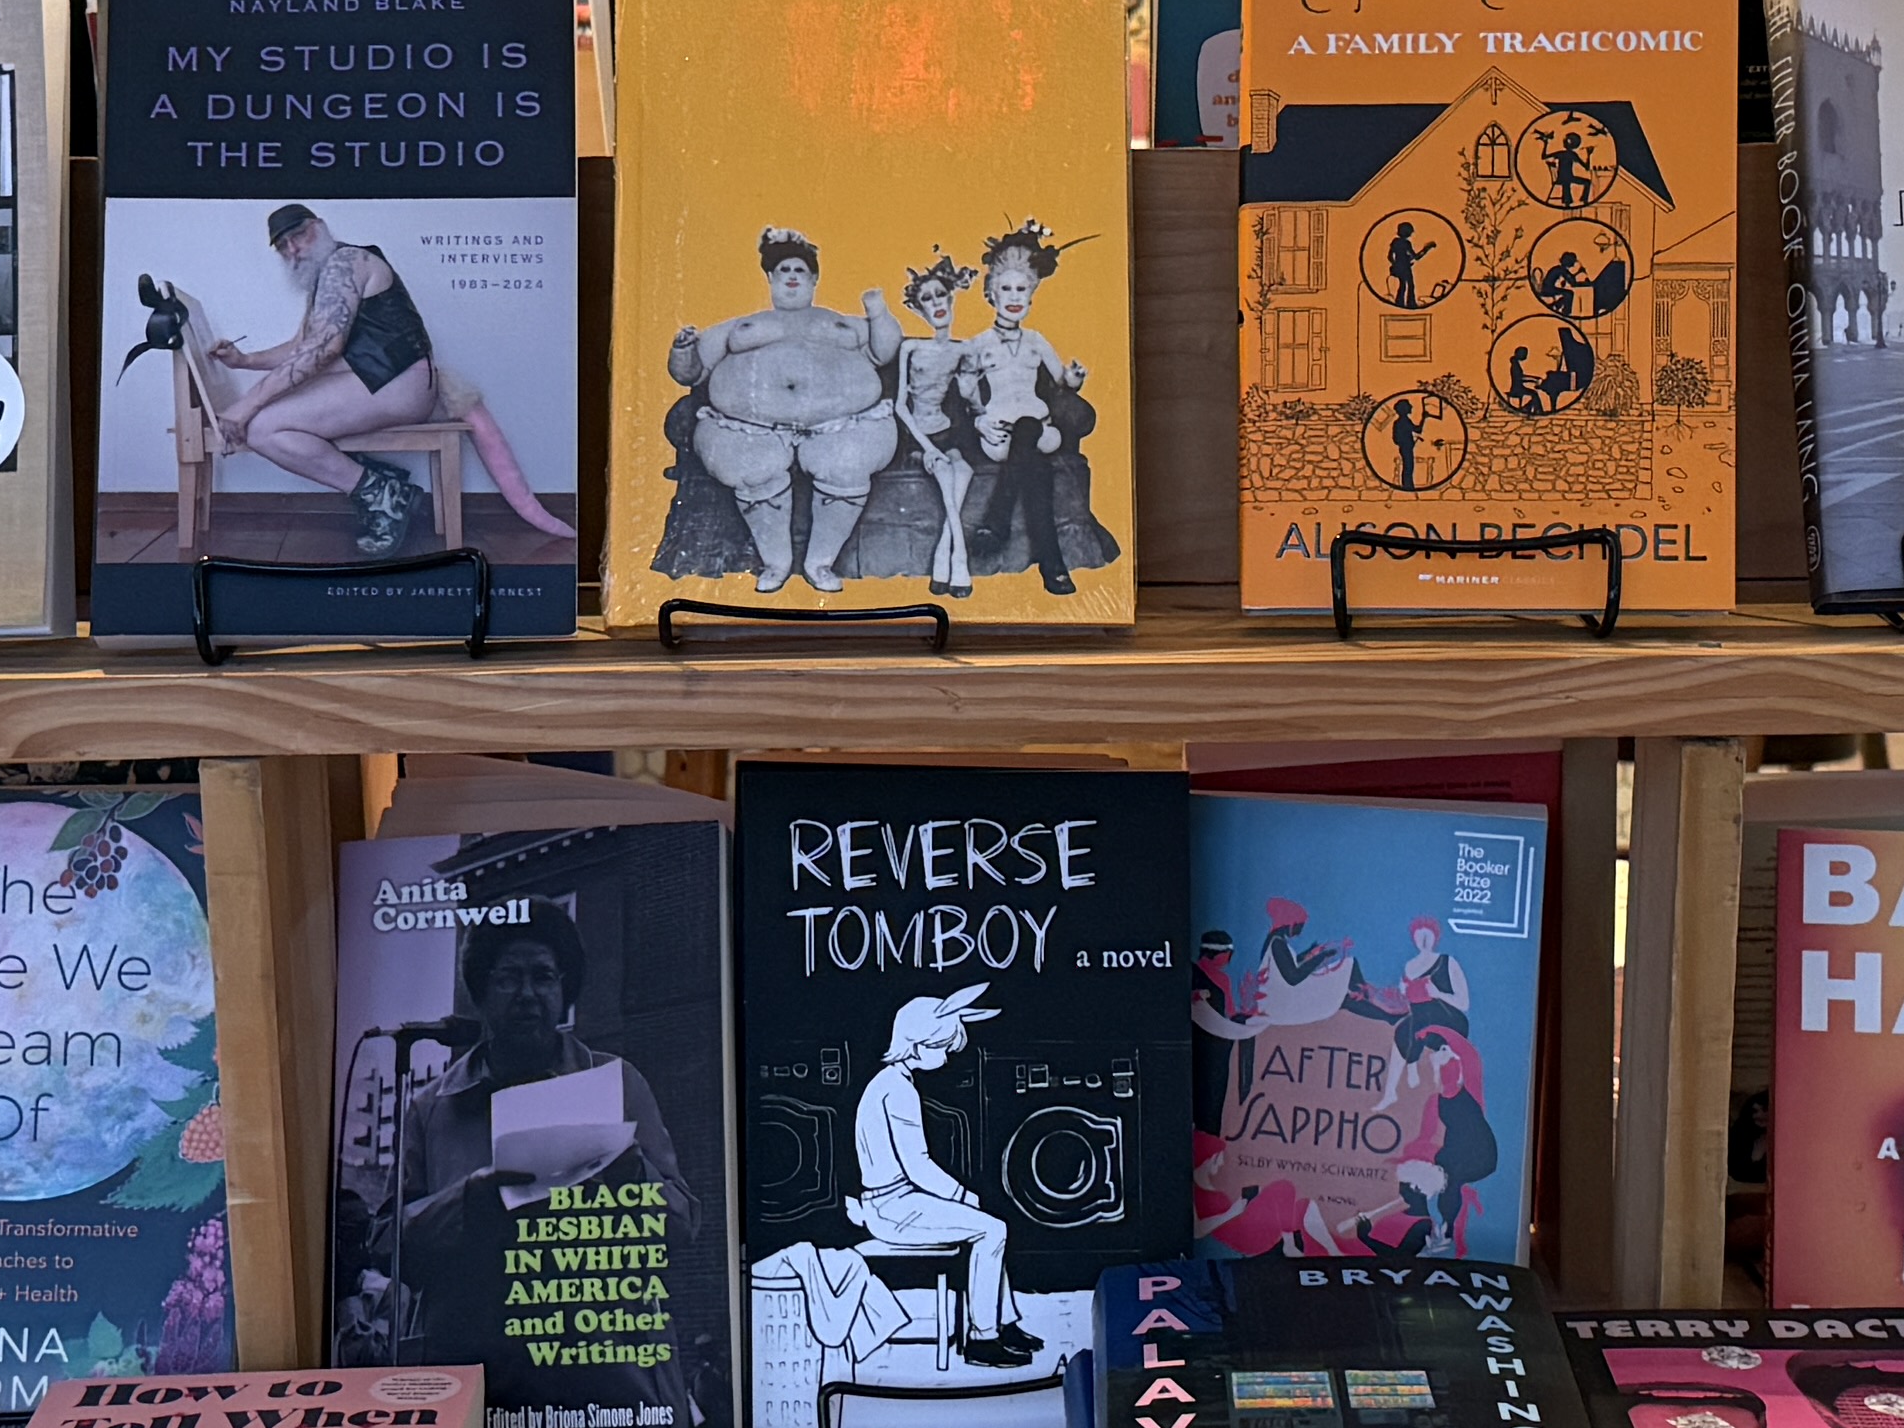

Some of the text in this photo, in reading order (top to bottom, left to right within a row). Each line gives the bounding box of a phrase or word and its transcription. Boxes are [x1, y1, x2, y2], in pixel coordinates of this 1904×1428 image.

[1288, 30, 1704, 56] A FAMILY TRAGICOMIC
[166, 42, 530, 75] MY STUDIO IS
[149, 89, 543, 122] A DUNGEON IS
[187, 138, 508, 170] THE STUDIO
[419, 234, 545, 249] WRITINGS AND
[441, 252, 545, 266] INTERVIEWS
[788, 818, 1097, 891] REVERSE
[1457, 843, 1483, 860] The
[1457, 859, 1510, 876] Booker
[373, 878, 467, 906] Anita
[1455, 874, 1491, 889] Prize
[1455, 888, 1492, 905] 2022
[373, 899, 531, 932] Cornwell
[787, 903, 1173, 977] TOMBOY a novel
[52, 942, 152, 991] We
[1260, 1044, 1385, 1093] AFTER
[1225, 1096, 1401, 1154] SAPPHO
[1877, 1137, 1898, 1162] A
[15, 1283, 78, 1303] Health
[1566, 1319, 1750, 1340] TERRY
[636, 1402, 673, 1428] Jones
